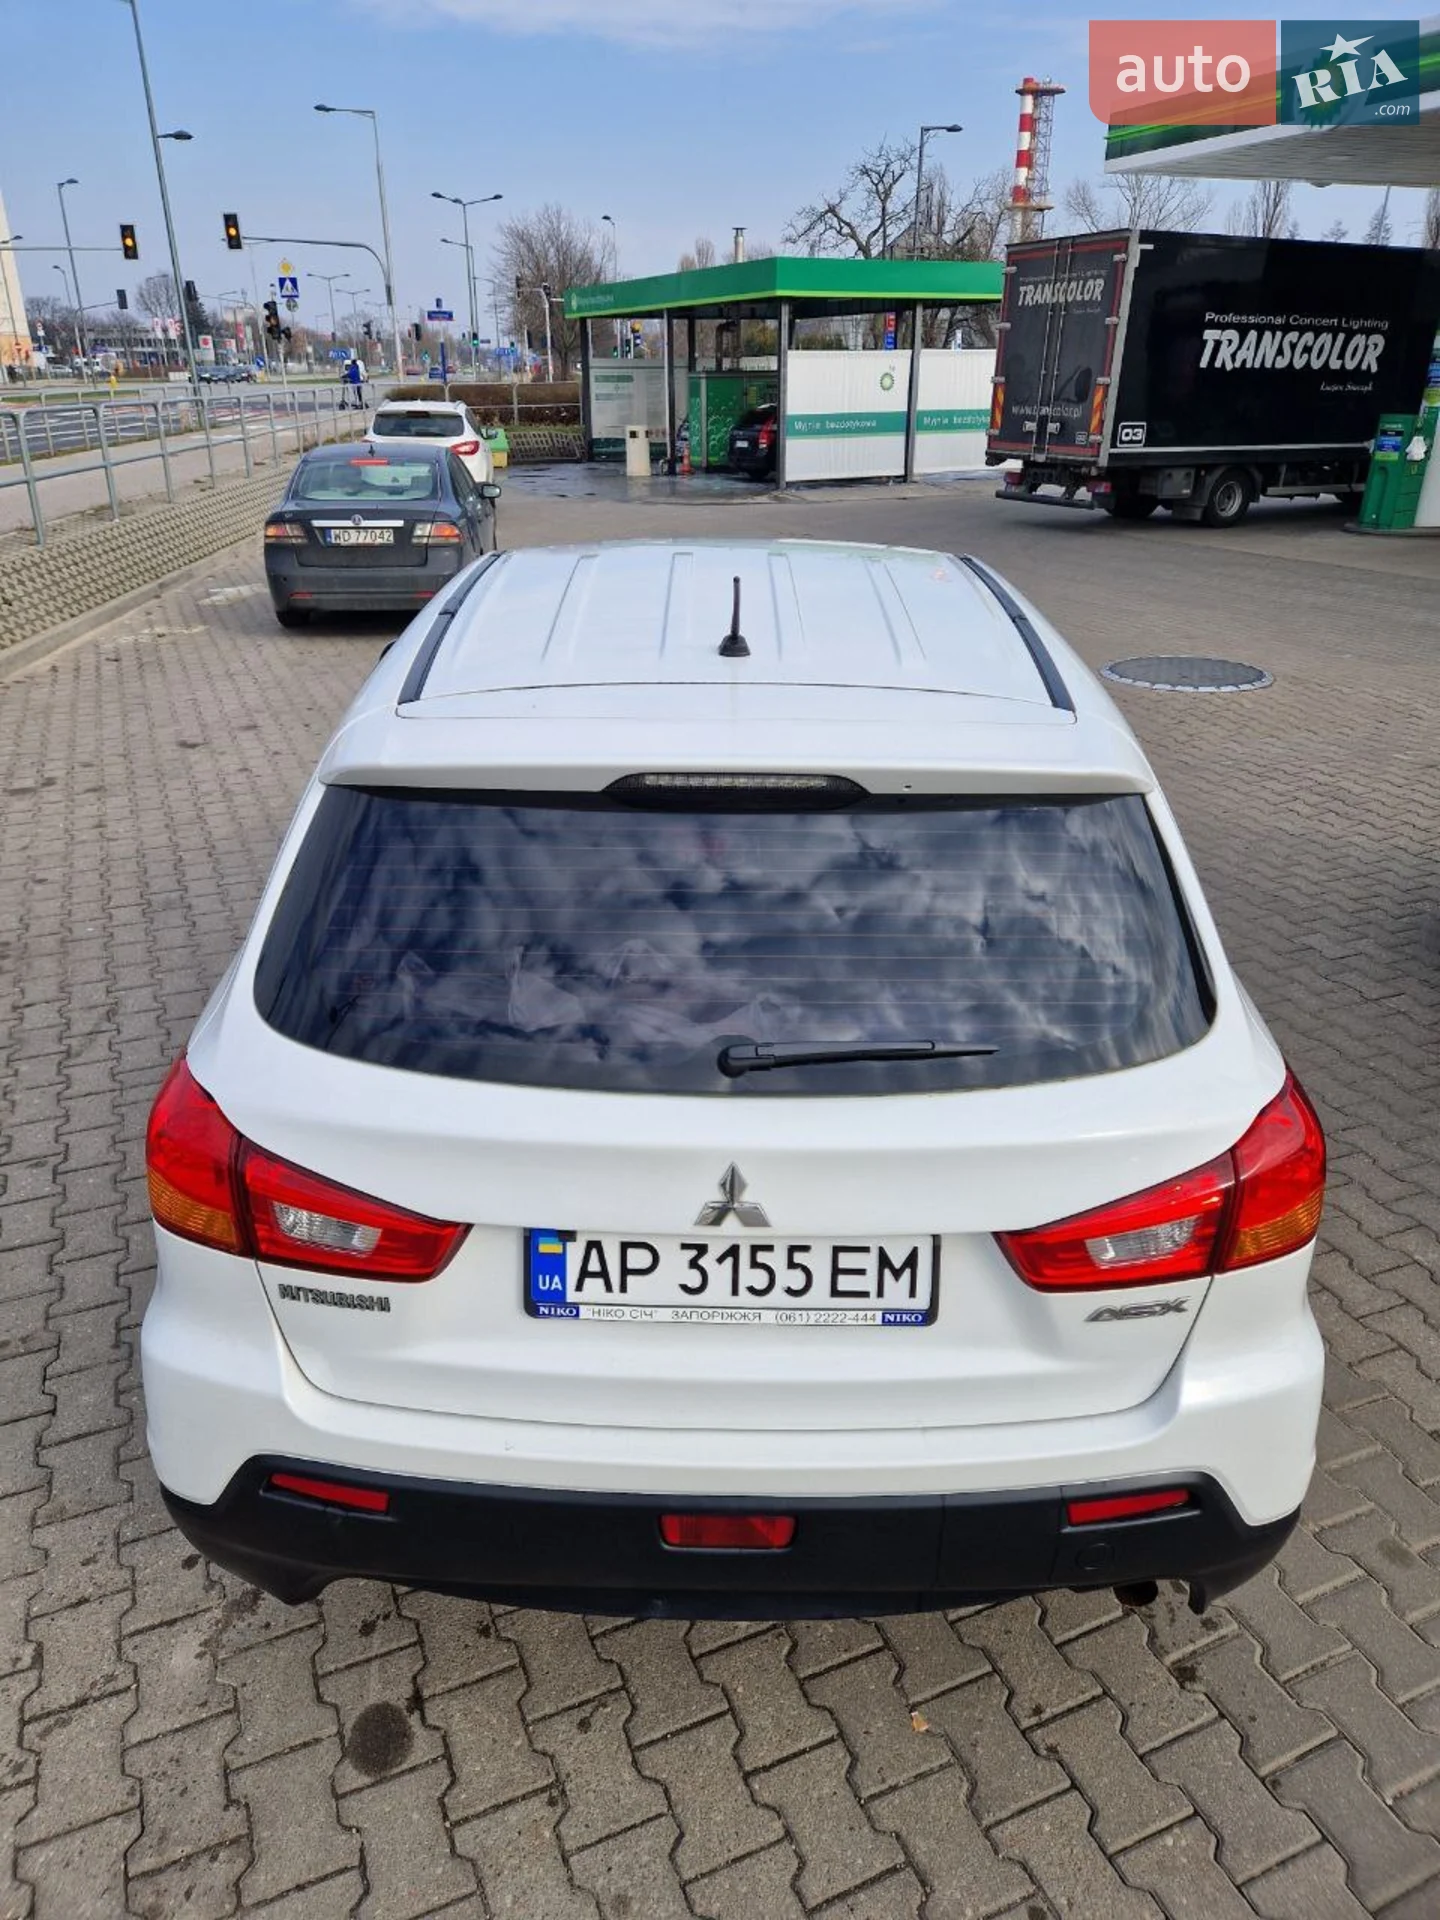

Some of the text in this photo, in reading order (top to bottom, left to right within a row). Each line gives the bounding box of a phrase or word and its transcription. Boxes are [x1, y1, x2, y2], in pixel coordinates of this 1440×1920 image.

[1018, 278, 1105, 307] TRANSCOLOR
[1204, 311, 1389, 330] Professional Concert Lighting
[1200, 329, 1385, 373] TRANSCOLOR
[1012, 404, 1082, 420] www.tancolor.pl
[1121, 428, 1143, 441] 03
[333, 530, 392, 542] WD 77042
[574, 1239, 919, 1299] AP 3155 EM
[538, 1274, 562, 1291] UA
[278, 1283, 391, 1313] MITSUBISHI
[538, 1305, 577, 1317] NIKO
[671, 1310, 761, 1322] ЗАПОРІЖЖЯ
[774, 1311, 811, 1325] (061)
[814, 1312, 877, 1324] 2222-444
[1084, 1296, 1190, 1322] ASX
[884, 1313, 922, 1323] NIKO
